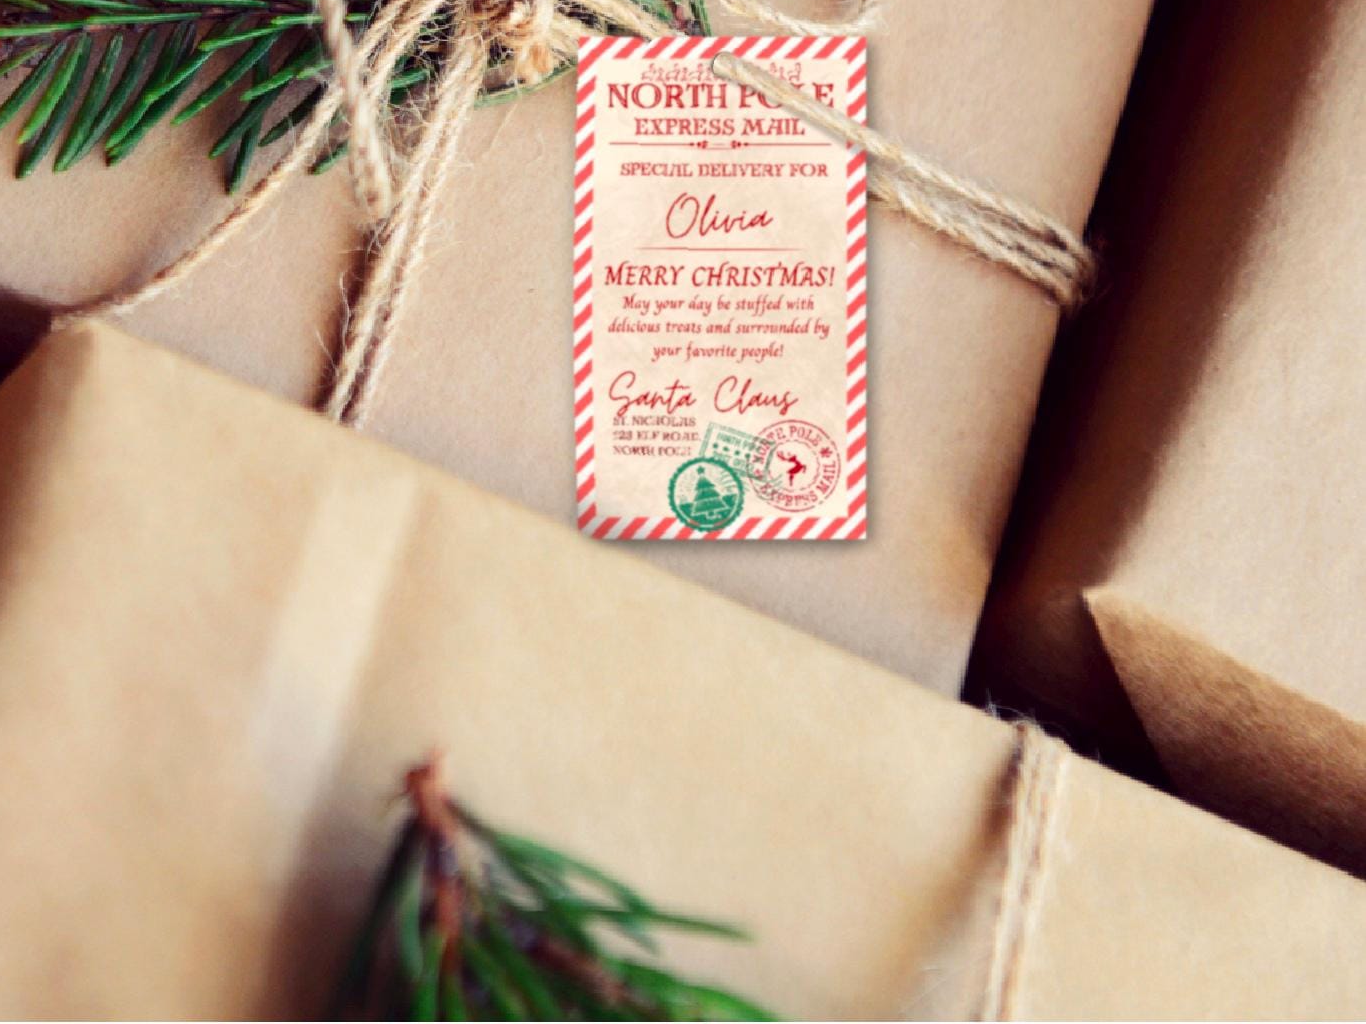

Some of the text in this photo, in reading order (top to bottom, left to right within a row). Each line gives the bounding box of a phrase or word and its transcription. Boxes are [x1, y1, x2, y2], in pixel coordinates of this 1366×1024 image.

[607, 82, 835, 109] NORTH POE
[634, 118, 805, 136] EXPRESS MAIL
[620, 162, 828, 177] SPECIAL DELIVERY FOR
[665, 192, 773, 239] Olivia
[604, 260, 835, 287] MERRY CHRISTMAS!
[622, 295, 814, 317] May your day be stuffed with
[608, 318, 830, 339] delicious treats and surrounded by
[651, 341, 784, 363] your favorite people!
[608, 370, 799, 417] Santa Claus
